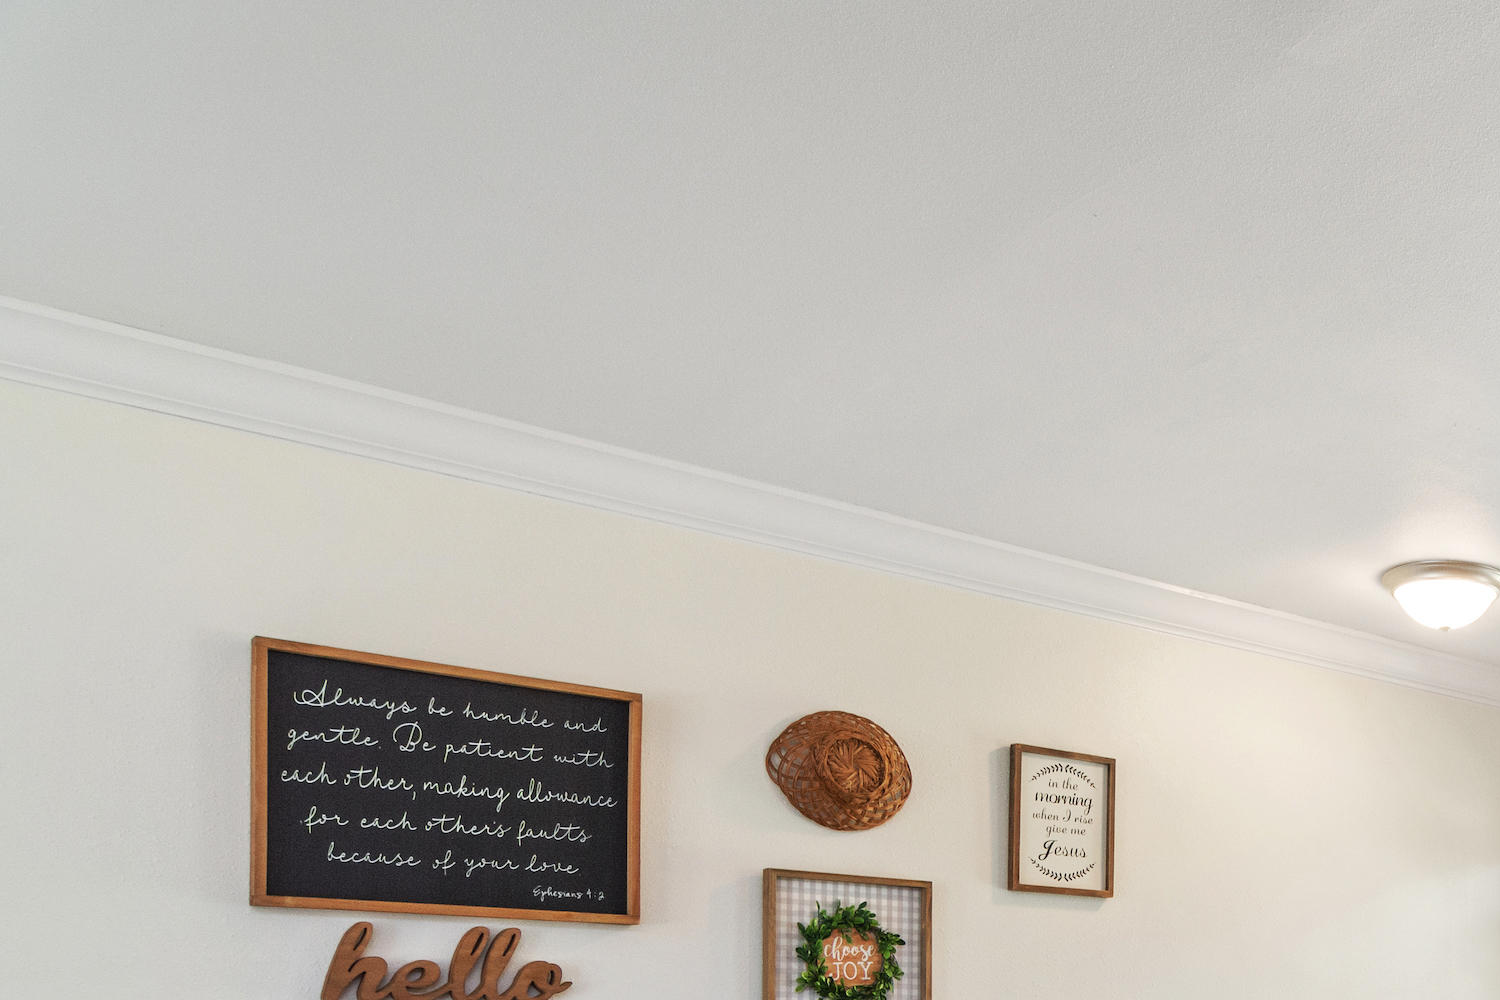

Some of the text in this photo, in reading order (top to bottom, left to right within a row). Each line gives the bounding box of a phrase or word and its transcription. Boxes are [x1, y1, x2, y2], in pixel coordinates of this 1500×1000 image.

[294, 680, 607, 733] Always be humble and
[287, 721, 614, 768] gentle. Be patient with
[281, 762, 617, 812] each other, making allowance
[1049, 778, 1078, 790] in the
[1035, 792, 1093, 814] morning
[304, 806, 592, 846] for each other's faults
[1032, 808, 1094, 825] when I rise
[1045, 826, 1087, 837] give me
[328, 842, 421, 866] because
[432, 850, 456, 876] of
[464, 858, 519, 878] your
[1038, 840, 1086, 860] Jesus
[533, 885, 583, 902] Ephesians
[824, 936, 876, 962] choose
[828, 962, 874, 980] JOY
